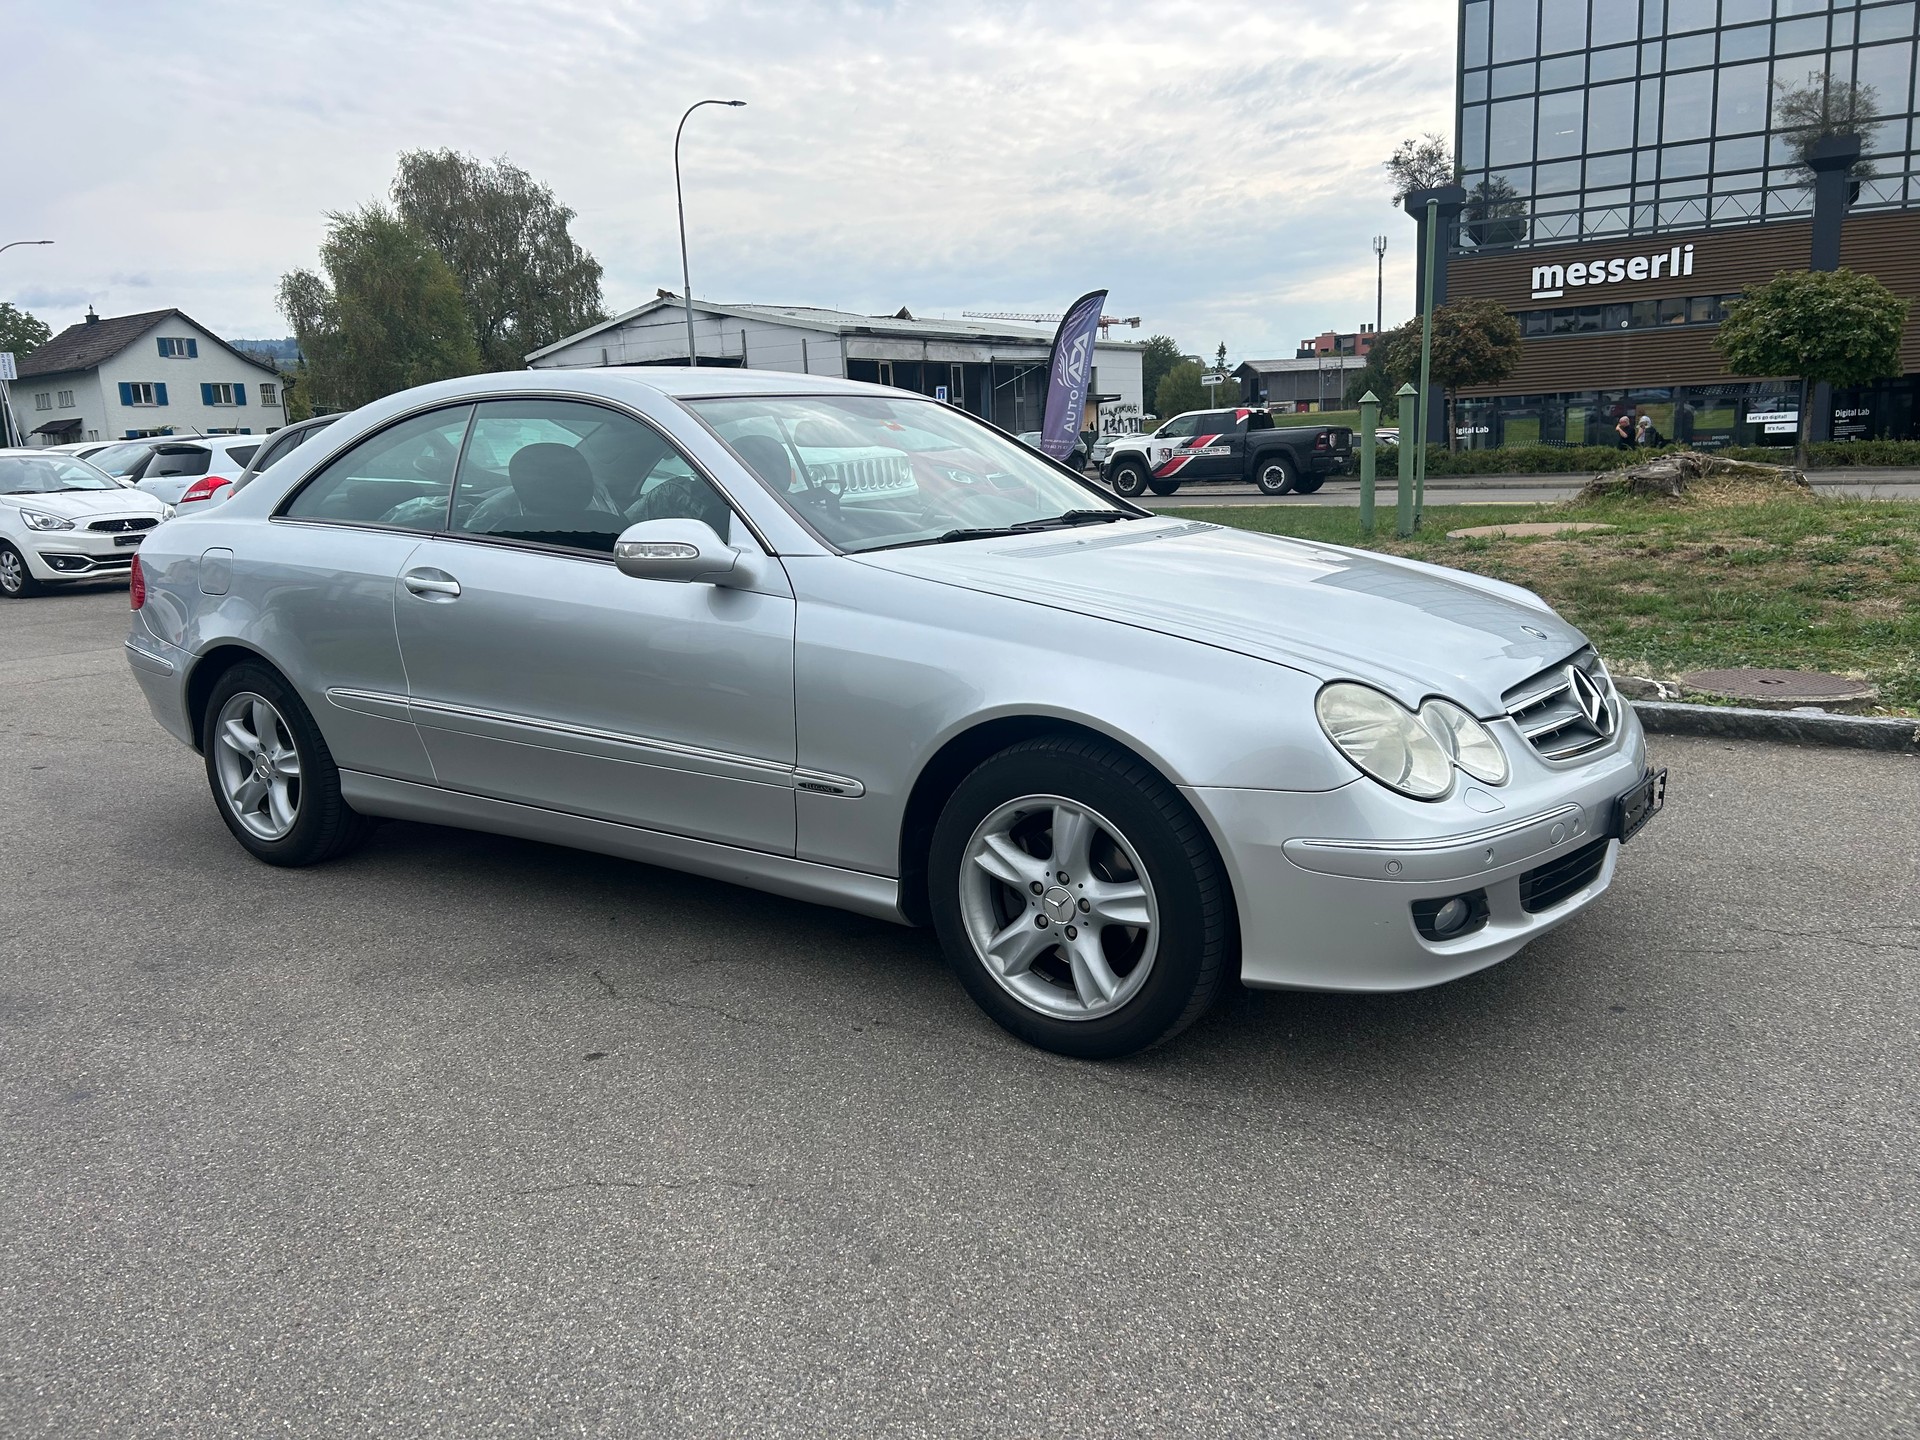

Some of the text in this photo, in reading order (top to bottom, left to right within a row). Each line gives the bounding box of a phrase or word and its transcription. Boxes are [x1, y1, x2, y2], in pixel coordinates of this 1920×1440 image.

[1532, 244, 1694, 297] messerli
[1063, 389, 1079, 433] AUTO
[1835, 408, 1870, 418] Digital Lab
[1455, 426, 1489, 435] igital Lab
[805, 782, 835, 793] ELEGANCE
